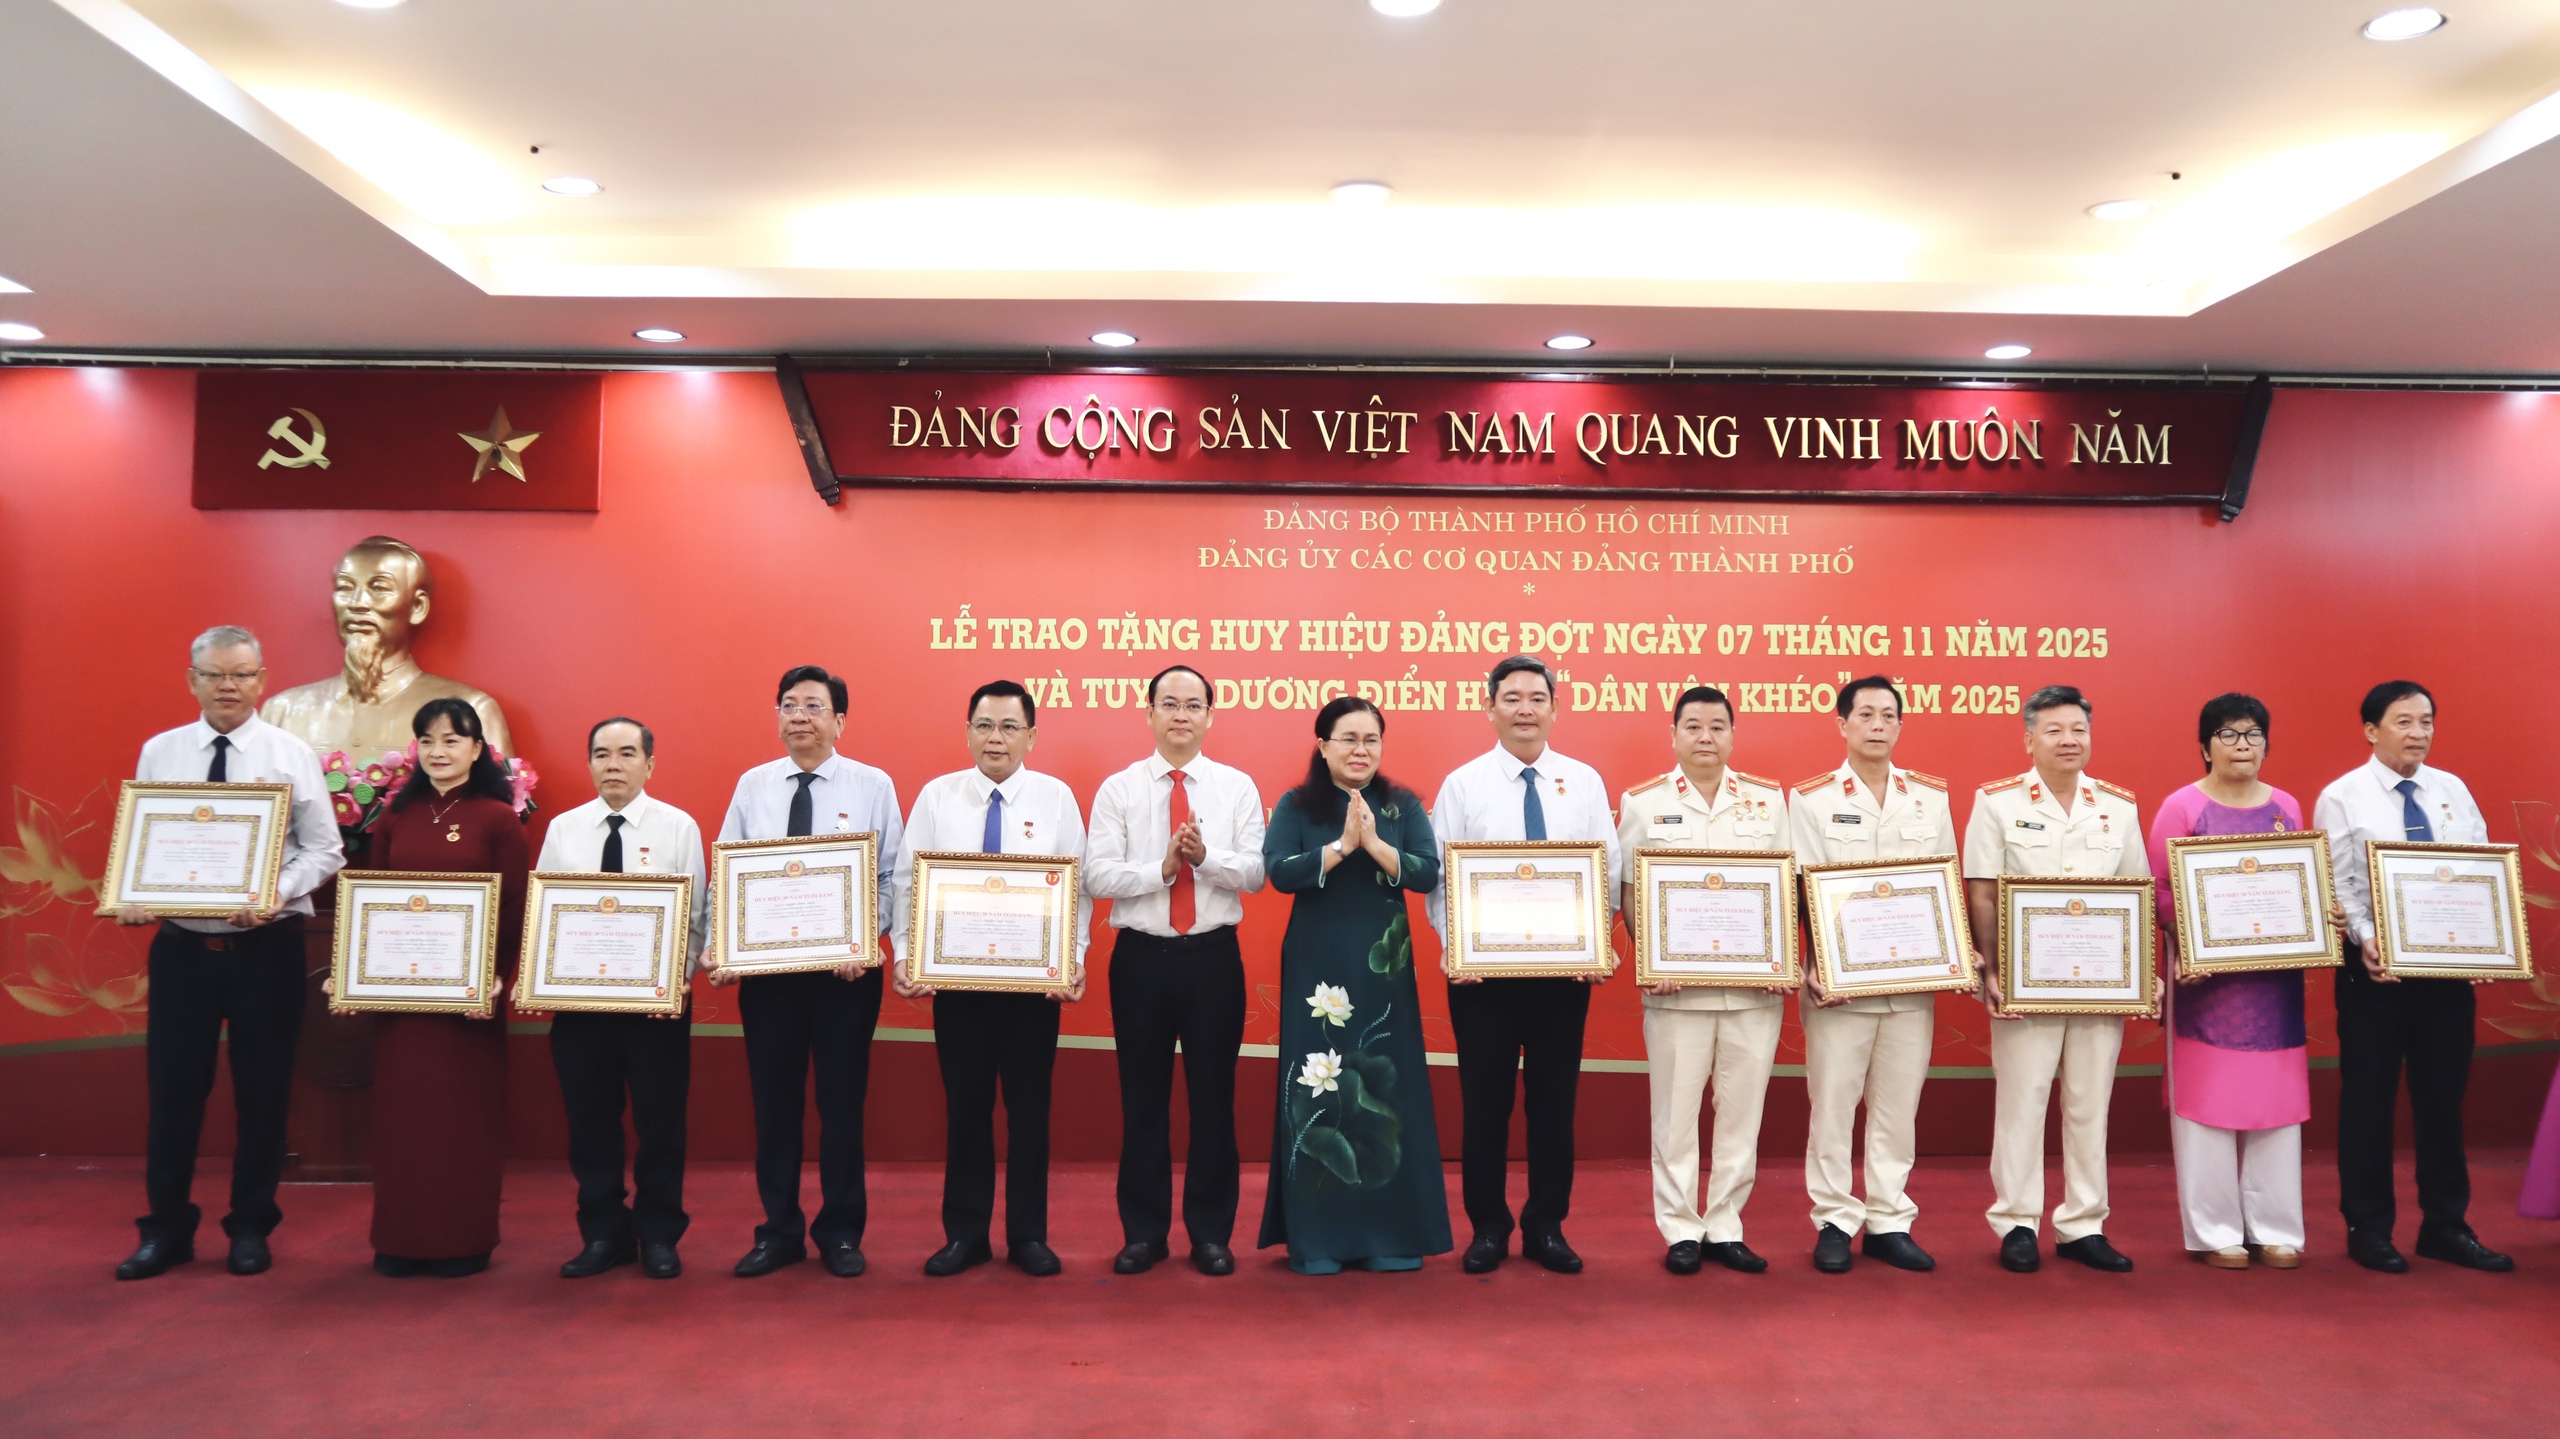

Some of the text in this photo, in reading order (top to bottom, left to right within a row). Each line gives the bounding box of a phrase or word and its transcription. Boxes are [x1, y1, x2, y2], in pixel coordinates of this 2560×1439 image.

[888, 390, 2173, 465] ĐẢNG CỘNG SẢN VIỆT NAM QUANG VINH MUÔN NĂM
[1263, 501, 1790, 536] ĐẢNG BỘ THÀNH PHỐ HỒ CHÍ MINH
[1197, 538, 1854, 576] ĐẢNG ỦY CÁC CƠ QUAN ĐẢNG THÀNH PHỐ
[929, 603, 2109, 662] LỄ TRAO TẶNG HUY HIỆU ĐẢNG ĐỢT NGÀY 07 THÁNG 11 NĂM 2025
[1024, 669, 1073, 708] VÀ
[1081, 677, 1153, 709] TUY
[1214, 675, 1349, 711] DƯƠNG
[1357, 664, 1448, 711] ĐIỂN
[1556, 669, 1649, 712] “DÂN
[1738, 671, 1852, 714] KHÉO”
[1891, 676, 1942, 714] ĂM
[1951, 684, 2021, 715] 2025
[1047, 873, 1059, 882] 17
